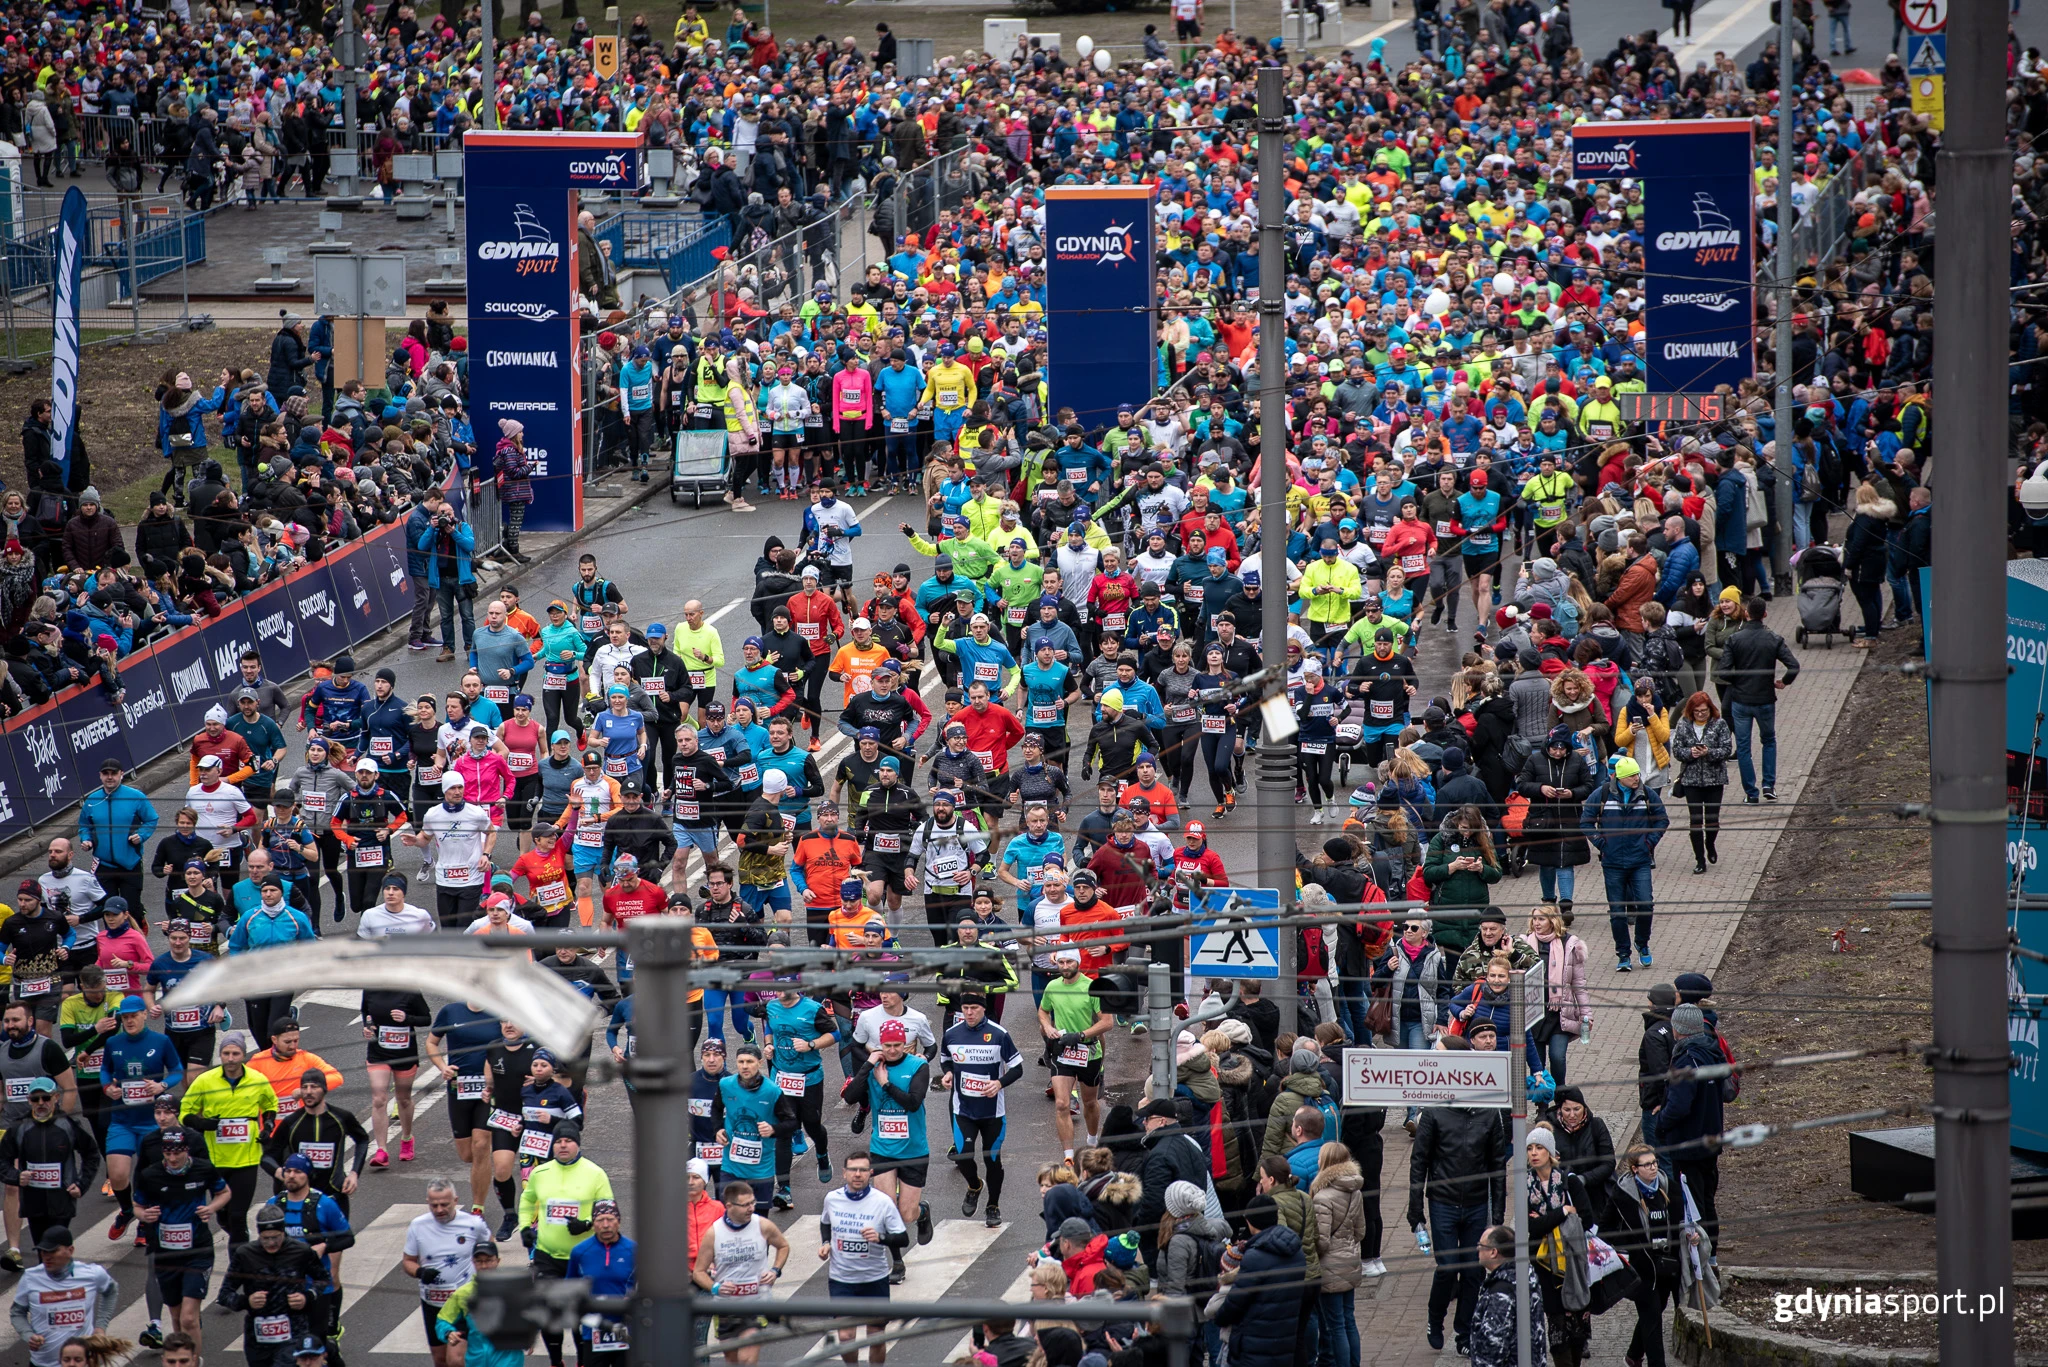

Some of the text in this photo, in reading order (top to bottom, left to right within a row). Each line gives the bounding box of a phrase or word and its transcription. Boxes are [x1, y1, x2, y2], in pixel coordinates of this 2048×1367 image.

[1577, 150, 1628, 164] GDYNIA
[569, 161, 619, 174] GDYNIA
[1055, 236, 1123, 252] GDYNIA
[1655, 230, 1741, 251] GDYNIA
[478, 241, 559, 260] GDYNIA
[1694, 245, 1740, 266] sport
[516, 257, 559, 276] sport
[1662, 293, 1723, 305] saucony
[484, 302, 543, 316] saucony
[51, 219, 77, 461] GDYNIA
[1663, 341, 1740, 360] CISOWIANKA
[486, 350, 559, 369] CISOWIANKA
[489, 401, 557, 411] POWERADE
[1407, 559, 1424, 567] 5079
[299, 589, 327, 621] saucony
[256, 610, 285, 642] saucony
[585, 620, 601, 628] 2827
[2006, 612, 2047, 632] hampionships
[801, 628, 818, 636] 2676
[2006, 634, 2047, 666] 2020
[214, 639, 239, 681] IAAF
[979, 668, 998, 676] 6220
[645, 682, 664, 690] 3926
[490, 690, 508, 699] 1152
[1375, 706, 1393, 714] 1079
[1206, 720, 1225, 729] 1394
[71, 712, 119, 754] POWERADE
[373, 742, 391, 750] 5447
[512, 758, 531, 766] 3152
[609, 763, 626, 772] 1367
[679, 805, 697, 813] 3304
[581, 832, 601, 841] 3099
[879, 838, 899, 847] 4728
[361, 852, 382, 861] 1582
[814, 859, 843, 867] adidas
[937, 861, 957, 871] 7006
[447, 868, 468, 877] 2449
[544, 888, 564, 899] 6456
[106, 973, 127, 983] 6532
[27, 980, 49, 992] 6219
[178, 1011, 196, 1021] 872
[1065, 1049, 1087, 1059] 4938
[1362, 1057, 1372, 1065] 21
[1418, 1058, 1438, 1068] ulica
[1361, 1067, 1497, 1087] ŚWIĘTOJAŃSKA
[782, 1078, 803, 1088] 1269
[12, 1083, 29, 1094] 523
[1402, 1090, 1456, 1100] Śródmieście
[226, 1125, 245, 1135] 748
[884, 1121, 907, 1131] 6514
[526, 1137, 549, 1151] 4282
[307, 1150, 332, 1160] 3295
[737, 1148, 760, 1158] 3653
[33, 1170, 59, 1180] 3989
[552, 1206, 578, 1217] 2325
[164, 1231, 190, 1241] 3608
[843, 1241, 868, 1251] 5509
[55, 1312, 84, 1323] 2209
[262, 1322, 288, 1334] 6576
